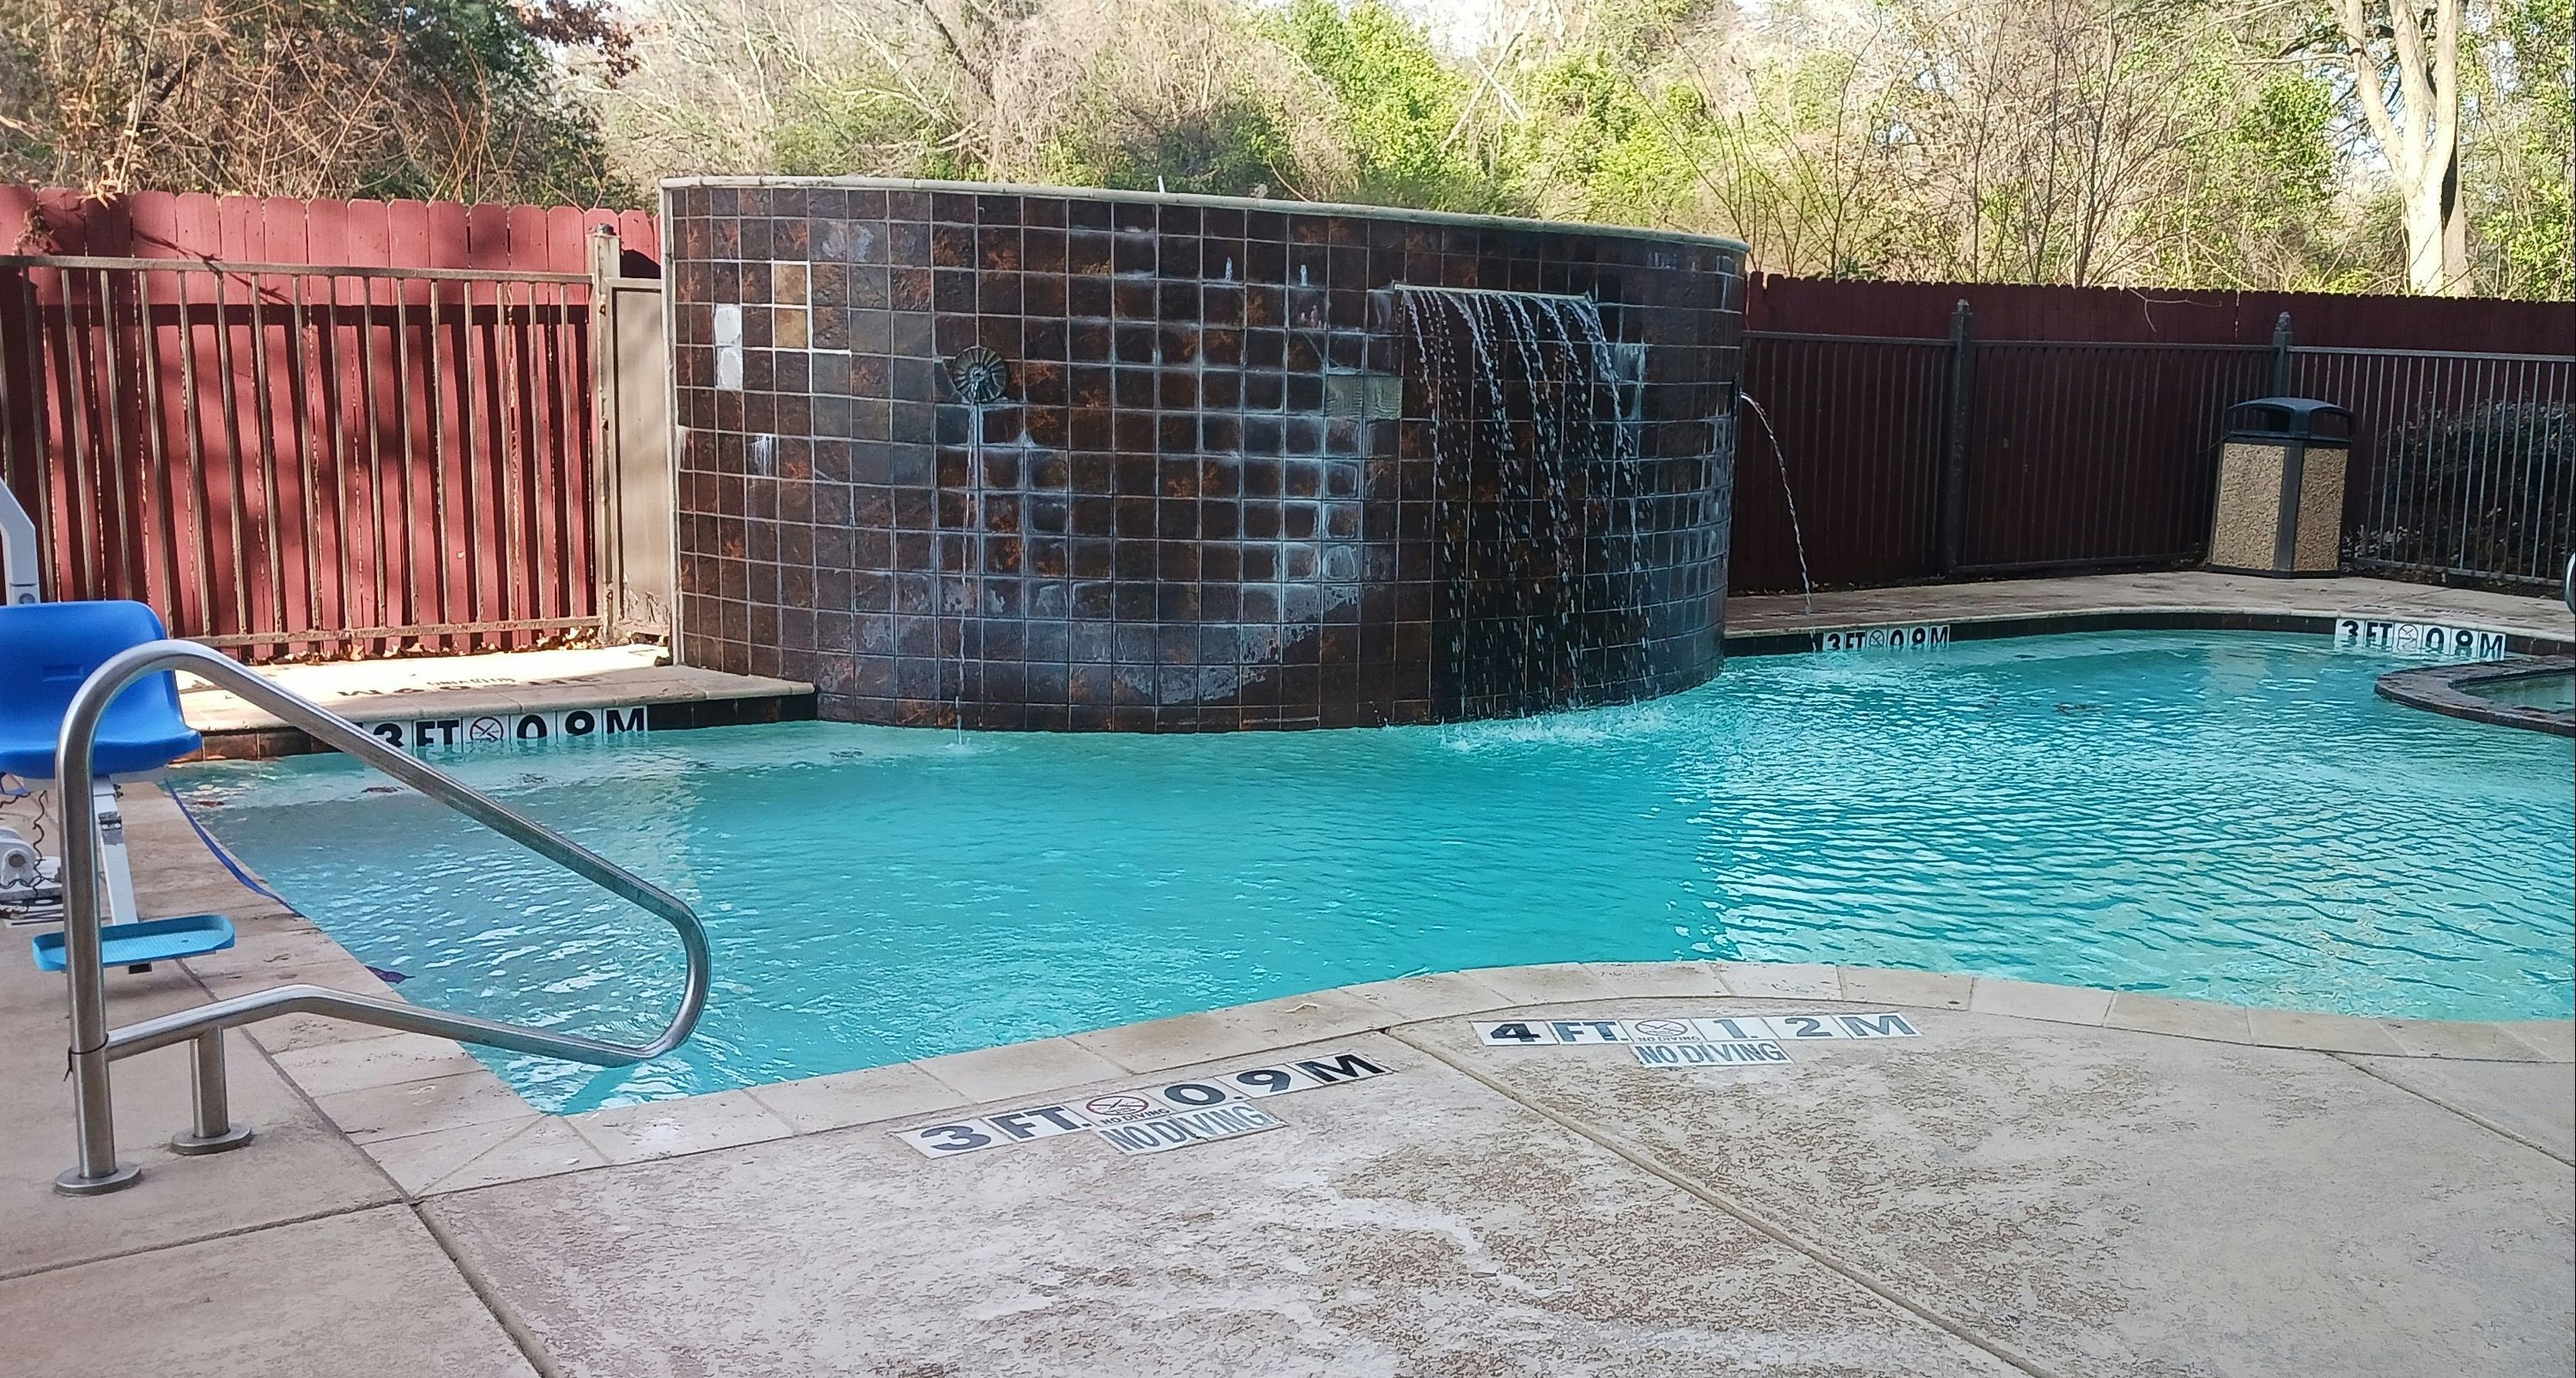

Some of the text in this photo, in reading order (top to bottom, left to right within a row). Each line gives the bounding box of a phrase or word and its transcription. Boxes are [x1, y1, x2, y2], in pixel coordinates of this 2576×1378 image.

[1930, 626, 1948, 647] M
[2479, 633, 2504, 657] M
[372, 722, 404, 749] 3
[605, 707, 644, 735] M
[1488, 1022, 1540, 1043] 4
[1838, 1015, 1916, 1036] M
[1635, 1042, 1788, 1065] NO DIVING
[920, 1125, 992, 1150] 3
[1294, 1053, 1386, 1083] M
[1100, 1106, 1267, 1151] NO DIVING
